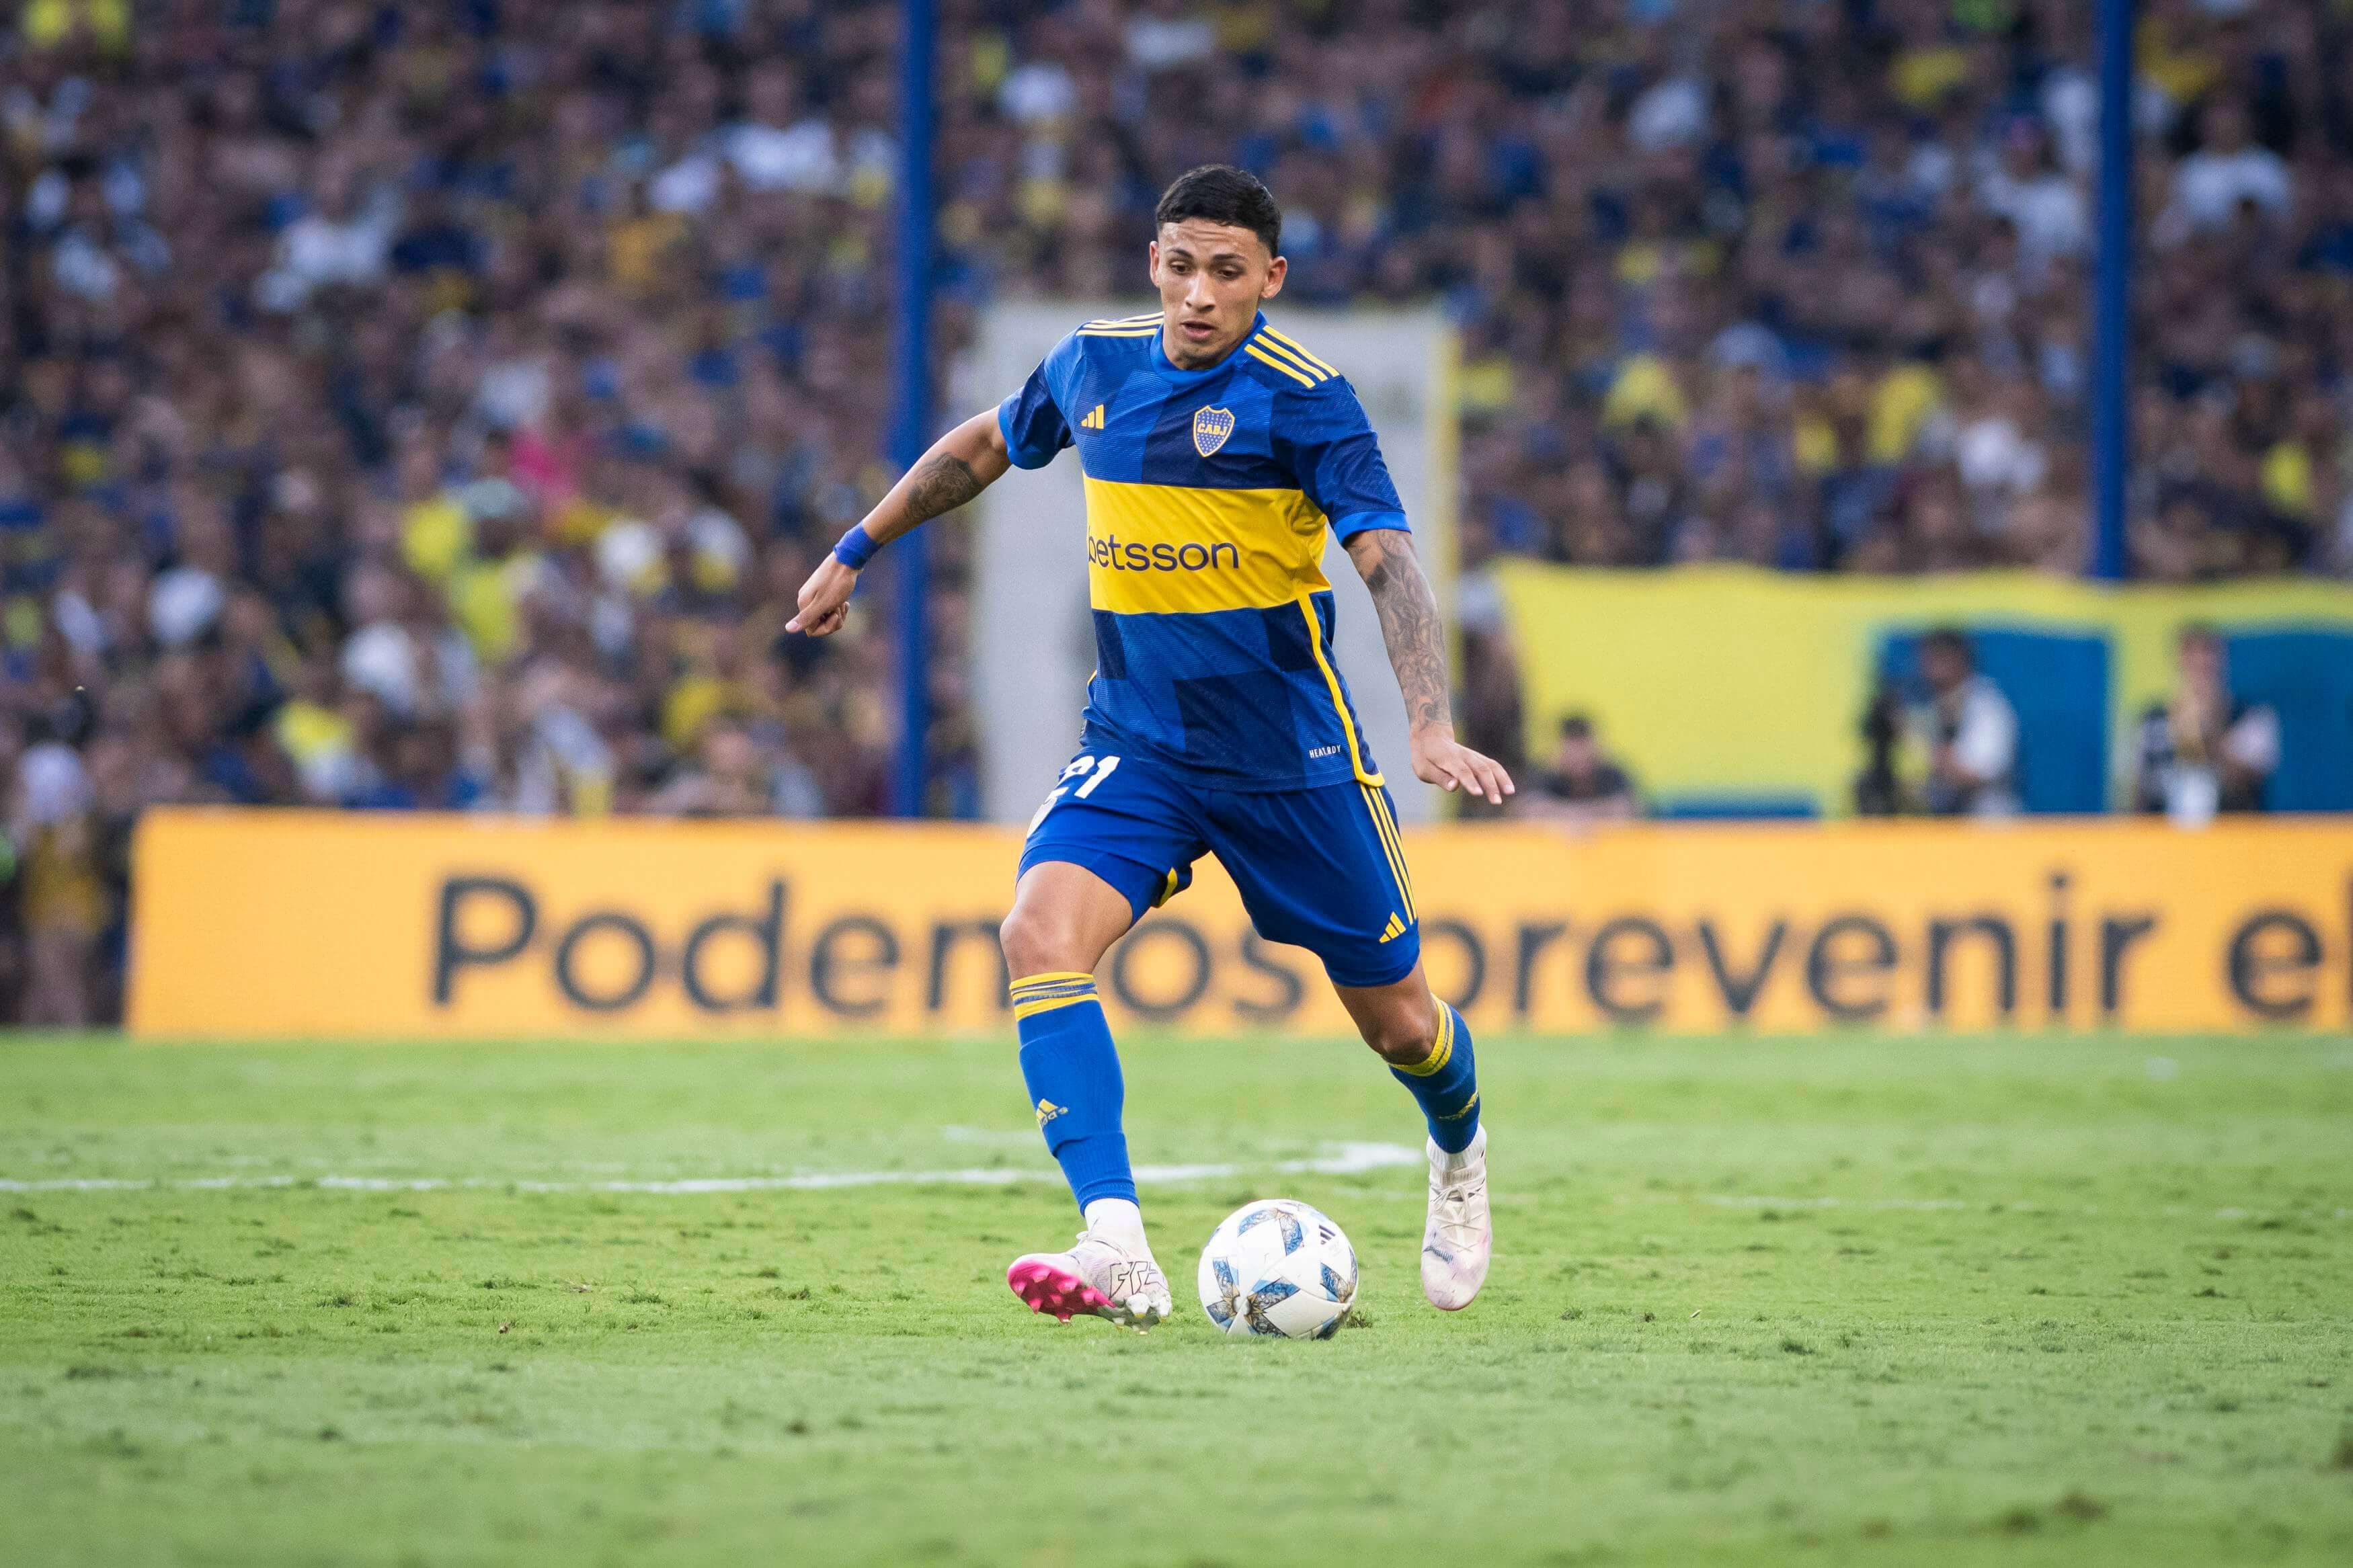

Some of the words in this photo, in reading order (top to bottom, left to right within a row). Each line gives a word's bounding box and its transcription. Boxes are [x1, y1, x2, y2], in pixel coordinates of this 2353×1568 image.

[1197, 423, 1228, 436] CABJ
[1088, 526, 1238, 571] betsson
[1044, 755, 1121, 800] 21
